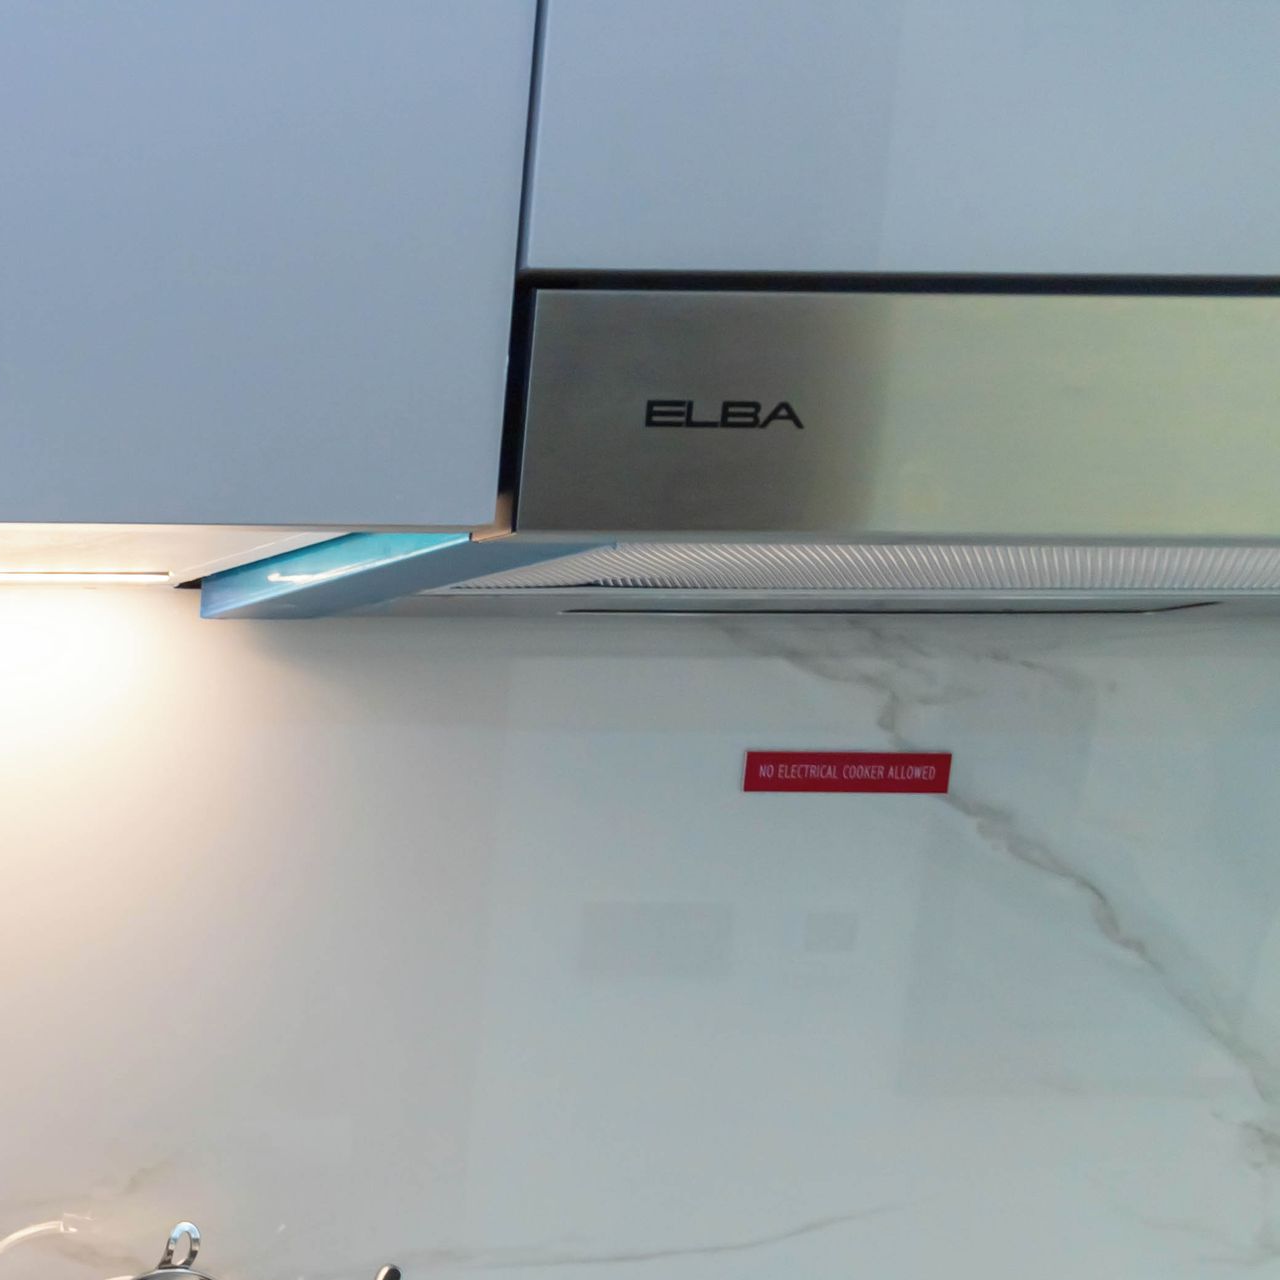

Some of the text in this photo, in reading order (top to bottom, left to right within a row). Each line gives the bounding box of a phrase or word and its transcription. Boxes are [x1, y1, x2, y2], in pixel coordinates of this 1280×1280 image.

[645, 399, 804, 429] ELBA
[759, 764, 936, 780] NO ELECTRICAL COOKER ALLOWED
